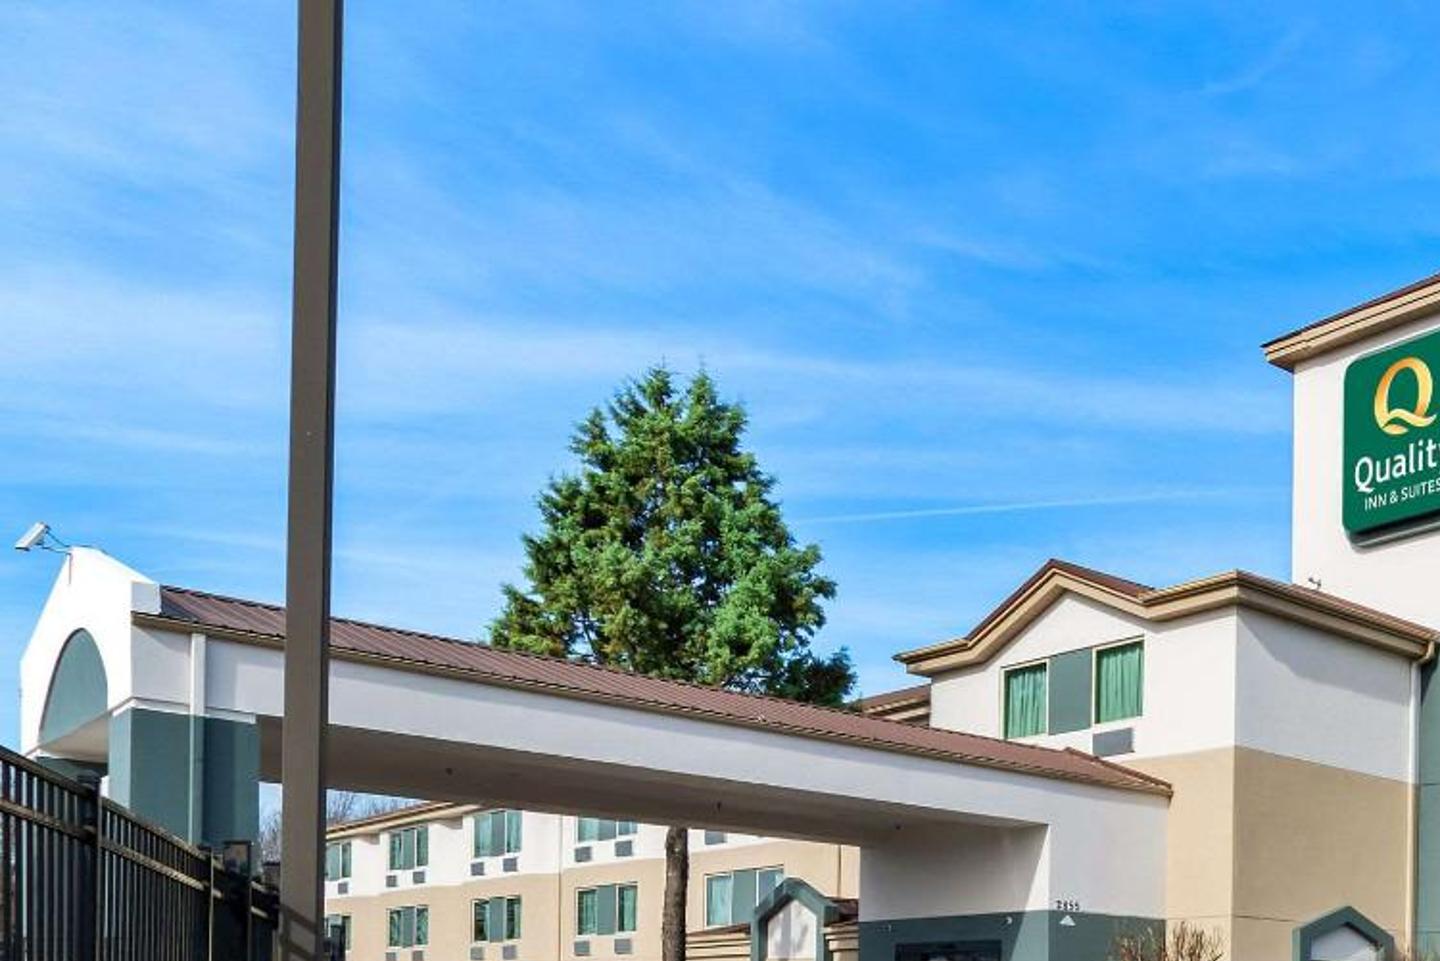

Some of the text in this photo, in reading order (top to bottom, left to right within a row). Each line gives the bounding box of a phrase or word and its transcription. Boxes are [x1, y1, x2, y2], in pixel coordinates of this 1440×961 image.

[1374, 356, 1437, 435] Q
[1364, 493, 1388, 511] INN
[1389, 490, 1399, 504] &
